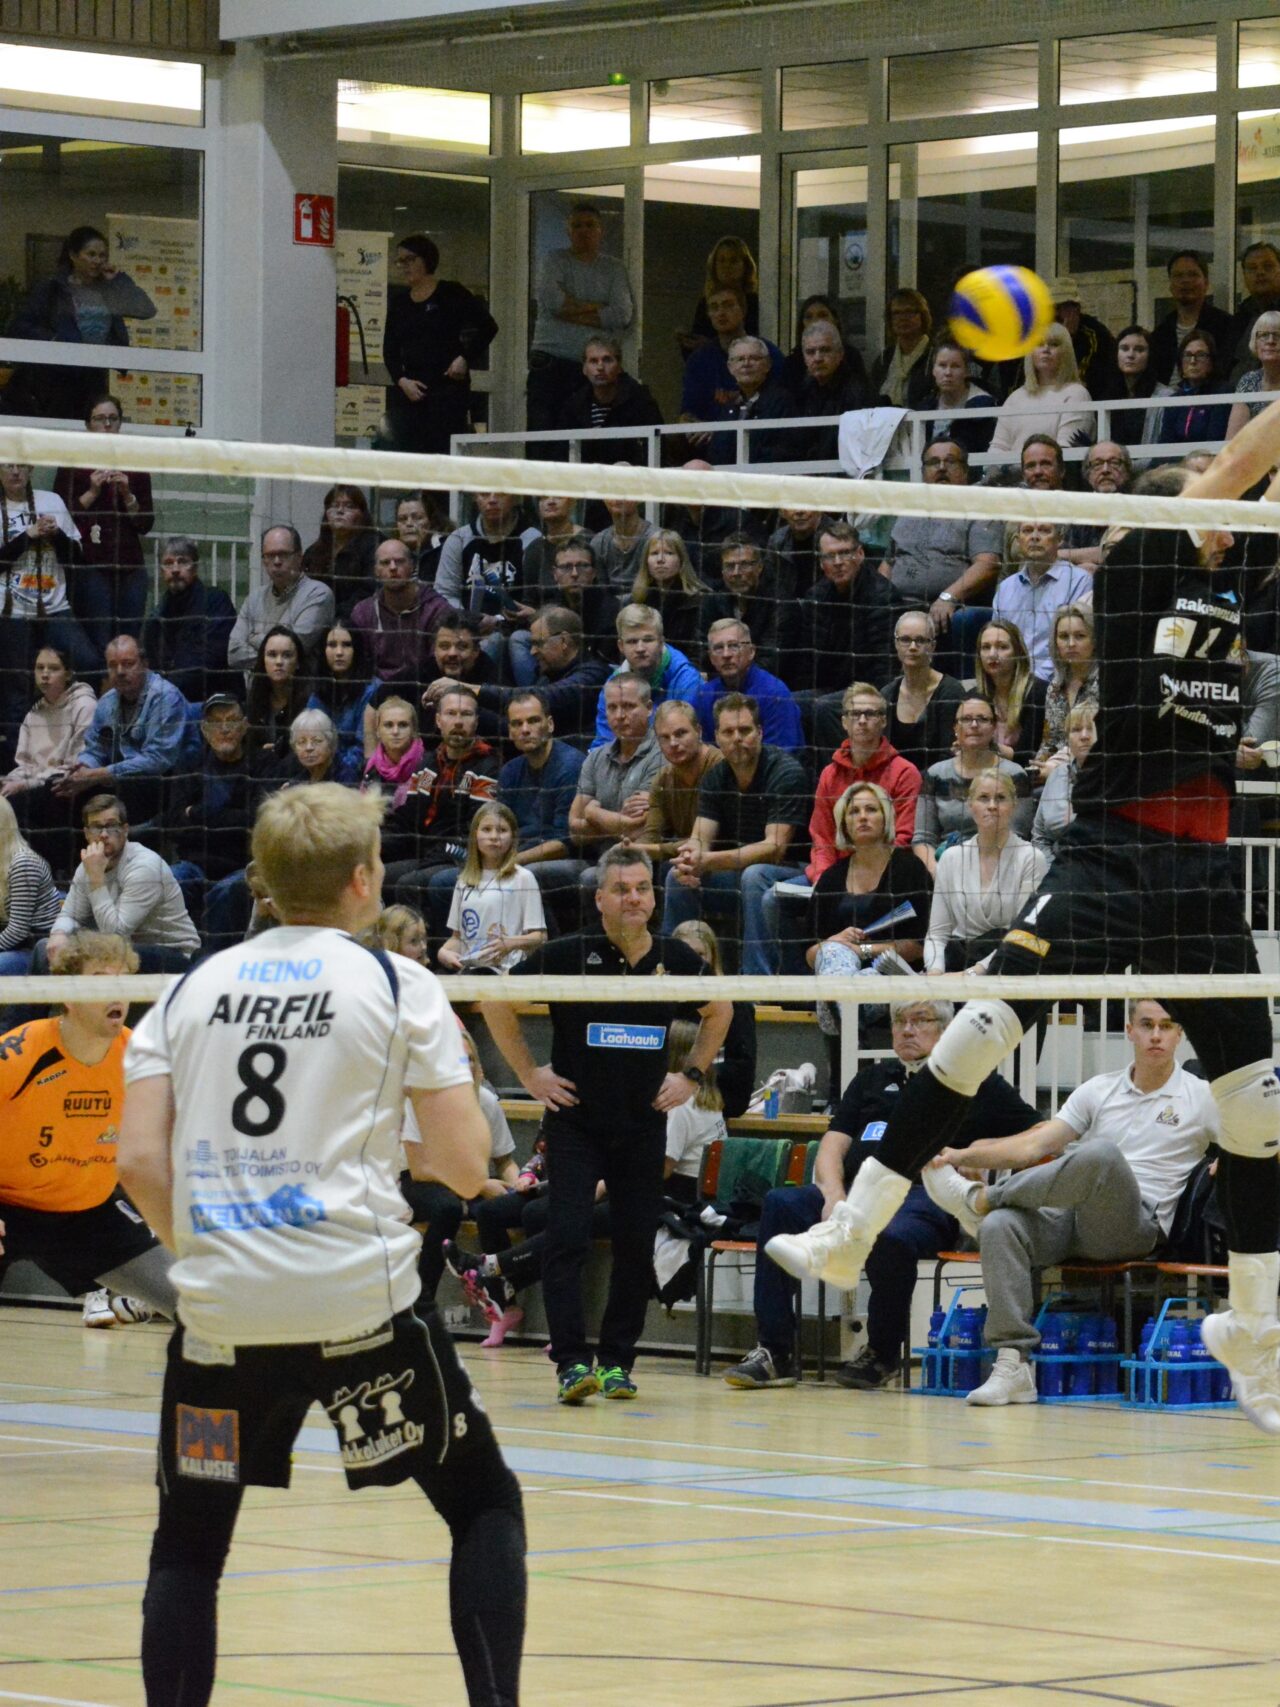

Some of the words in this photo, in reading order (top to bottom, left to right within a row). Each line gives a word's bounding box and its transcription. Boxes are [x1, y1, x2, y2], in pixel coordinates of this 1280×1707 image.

[237, 958, 324, 983] HEINO
[207, 989, 338, 1027] AIRFIL
[244, 1022, 332, 1041] FINLAND
[600, 1032, 660, 1047] Laatuauto
[231, 1041, 289, 1138] 8
[63, 1097, 112, 1111] RUUTU
[38, 1126, 54, 1148] 5
[304, 1161, 323, 1176] OY
[182, 1410, 235, 1461] PM
[404, 1419, 425, 1445] Oy
[453, 1411, 468, 1438] 8
[180, 1454, 237, 1479] KALUSTE
